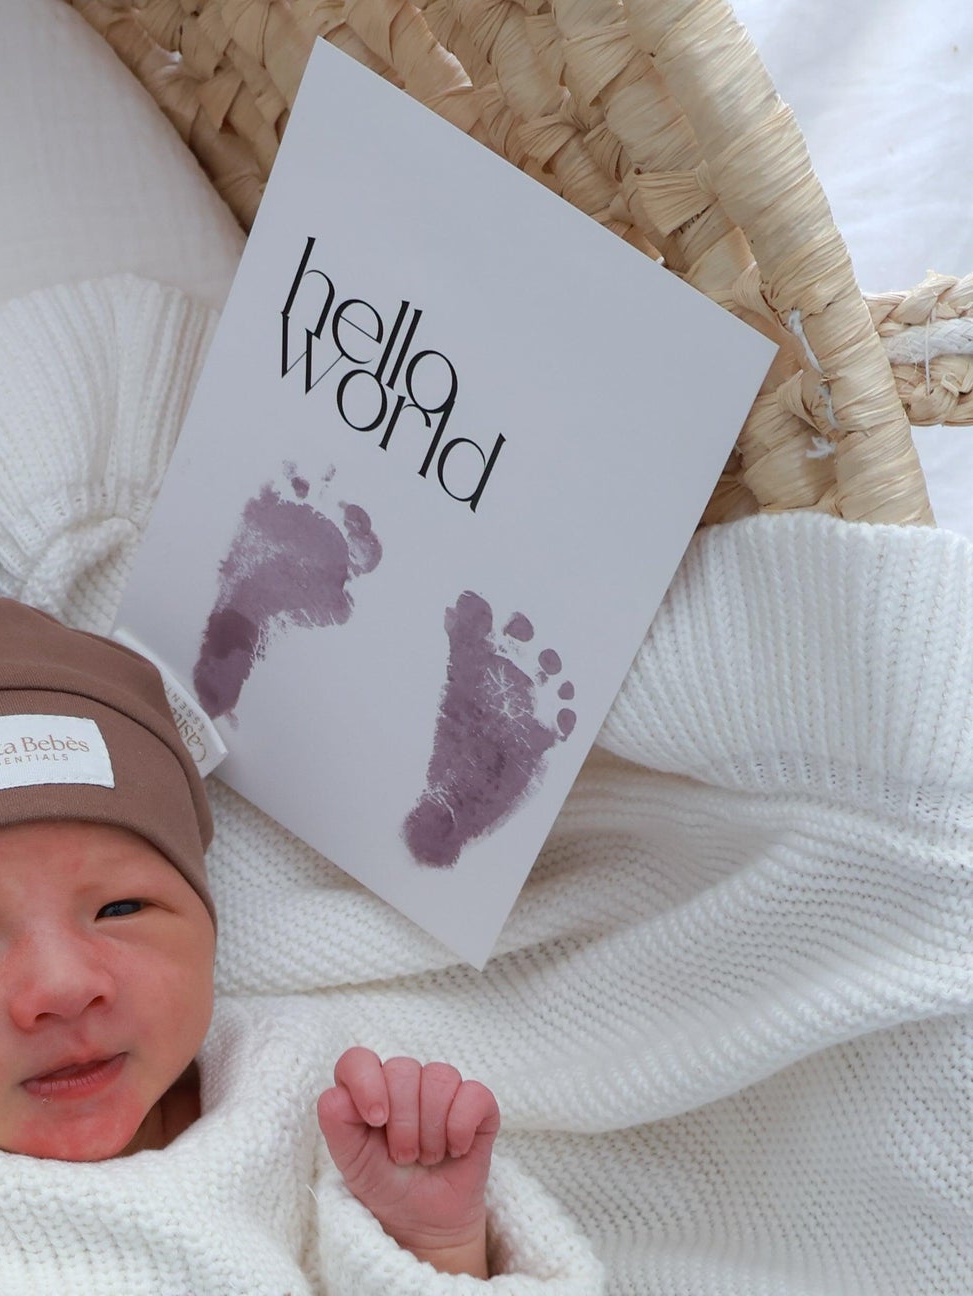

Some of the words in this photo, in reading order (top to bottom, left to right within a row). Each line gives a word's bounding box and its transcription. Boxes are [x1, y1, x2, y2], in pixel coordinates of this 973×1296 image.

[281, 236, 458, 414] hello
[281, 311, 507, 513] world
[21, 734, 90, 753] Bebès
[164, 679, 204, 732] ESSENT
